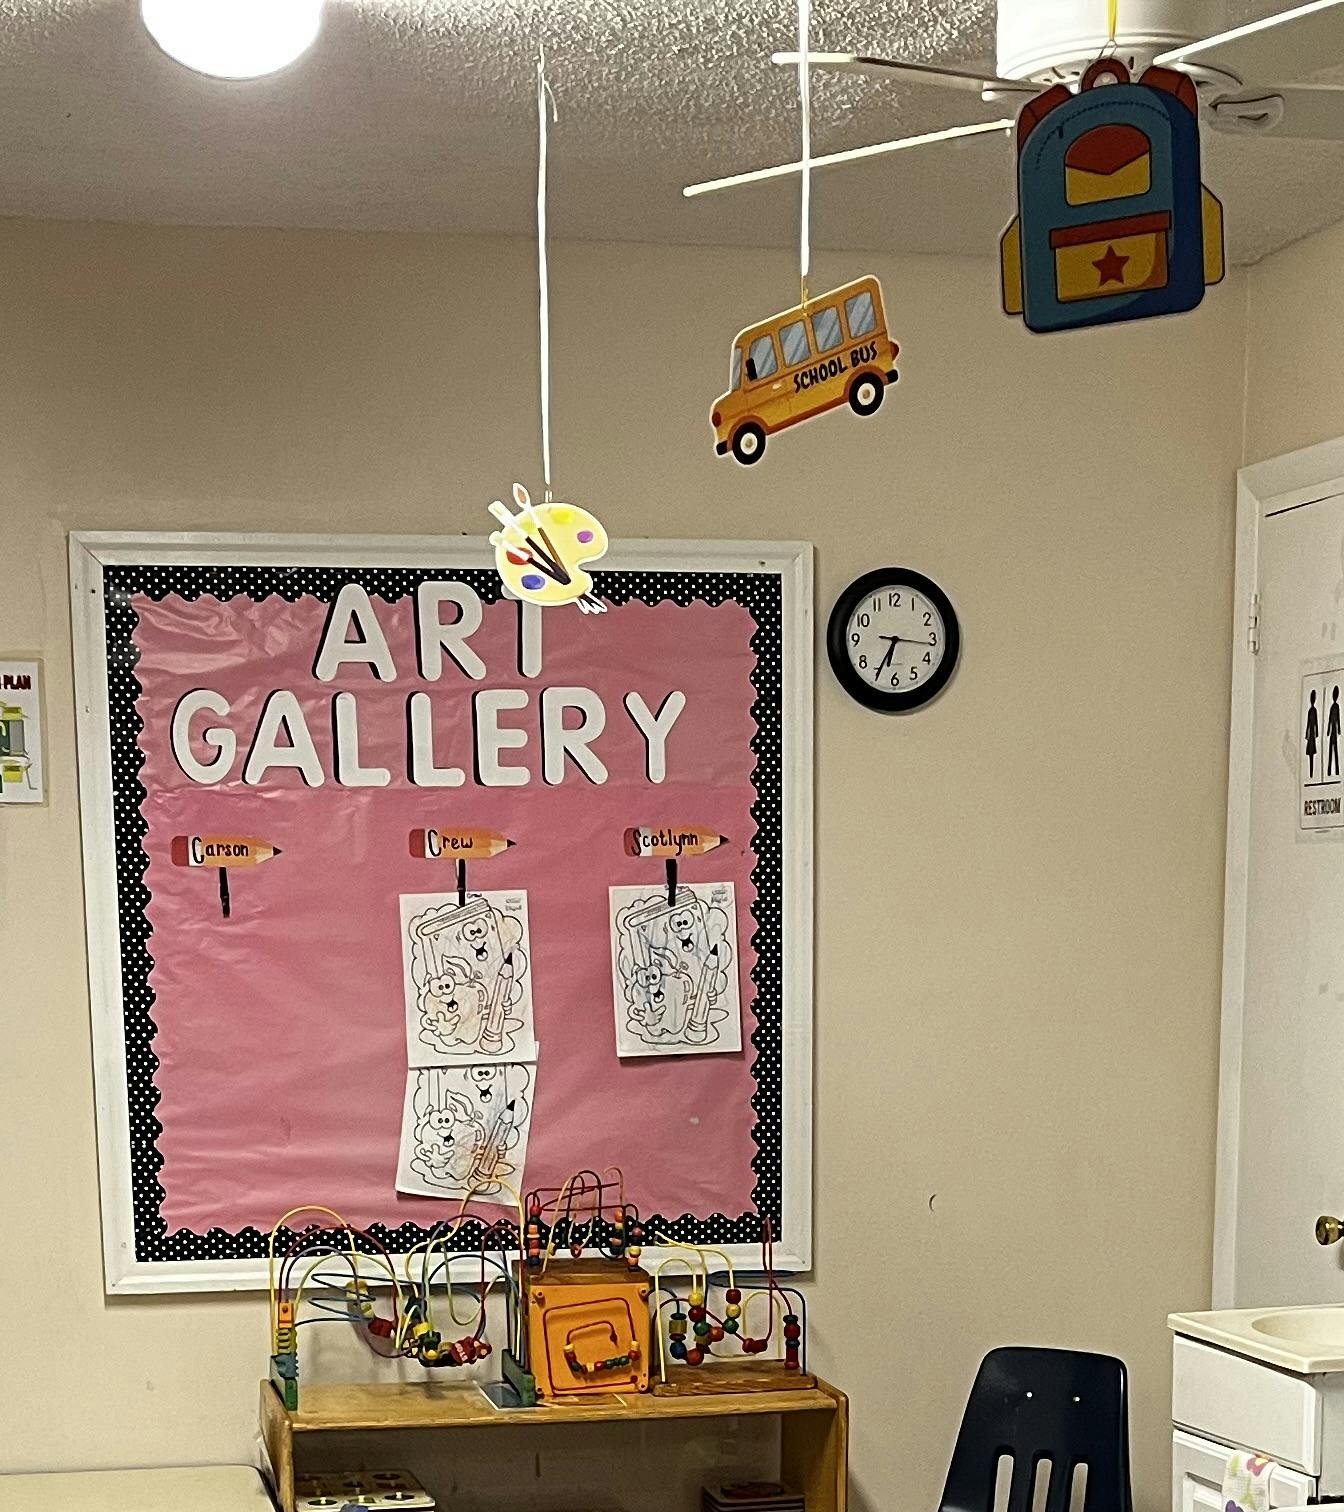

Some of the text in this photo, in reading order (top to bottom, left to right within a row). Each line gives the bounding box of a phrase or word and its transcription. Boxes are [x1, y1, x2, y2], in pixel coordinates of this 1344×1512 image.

[793, 341, 878, 393] SCHOOL BUS
[873, 597, 881, 612] 11
[889, 593, 901, 607] 12
[857, 613, 870, 627] 10
[923, 612, 932, 626] 2
[311, 581, 546, 682] ART
[851, 633, 860, 647] 9
[929, 632, 937, 646] 3
[859, 655, 867, 669] 8
[922, 651, 931, 665] 4
[891, 672, 899, 686] 6
[909, 666, 918, 680] 5
[3, 674, 31, 690] PLAN
[170, 688, 687, 788] GALLERY
[1304, 798, 1341, 815] RESTROOM
[428, 829, 473, 857] Crew
[631, 828, 699, 857] Scotlynn
[192, 836, 249, 864] Carson
